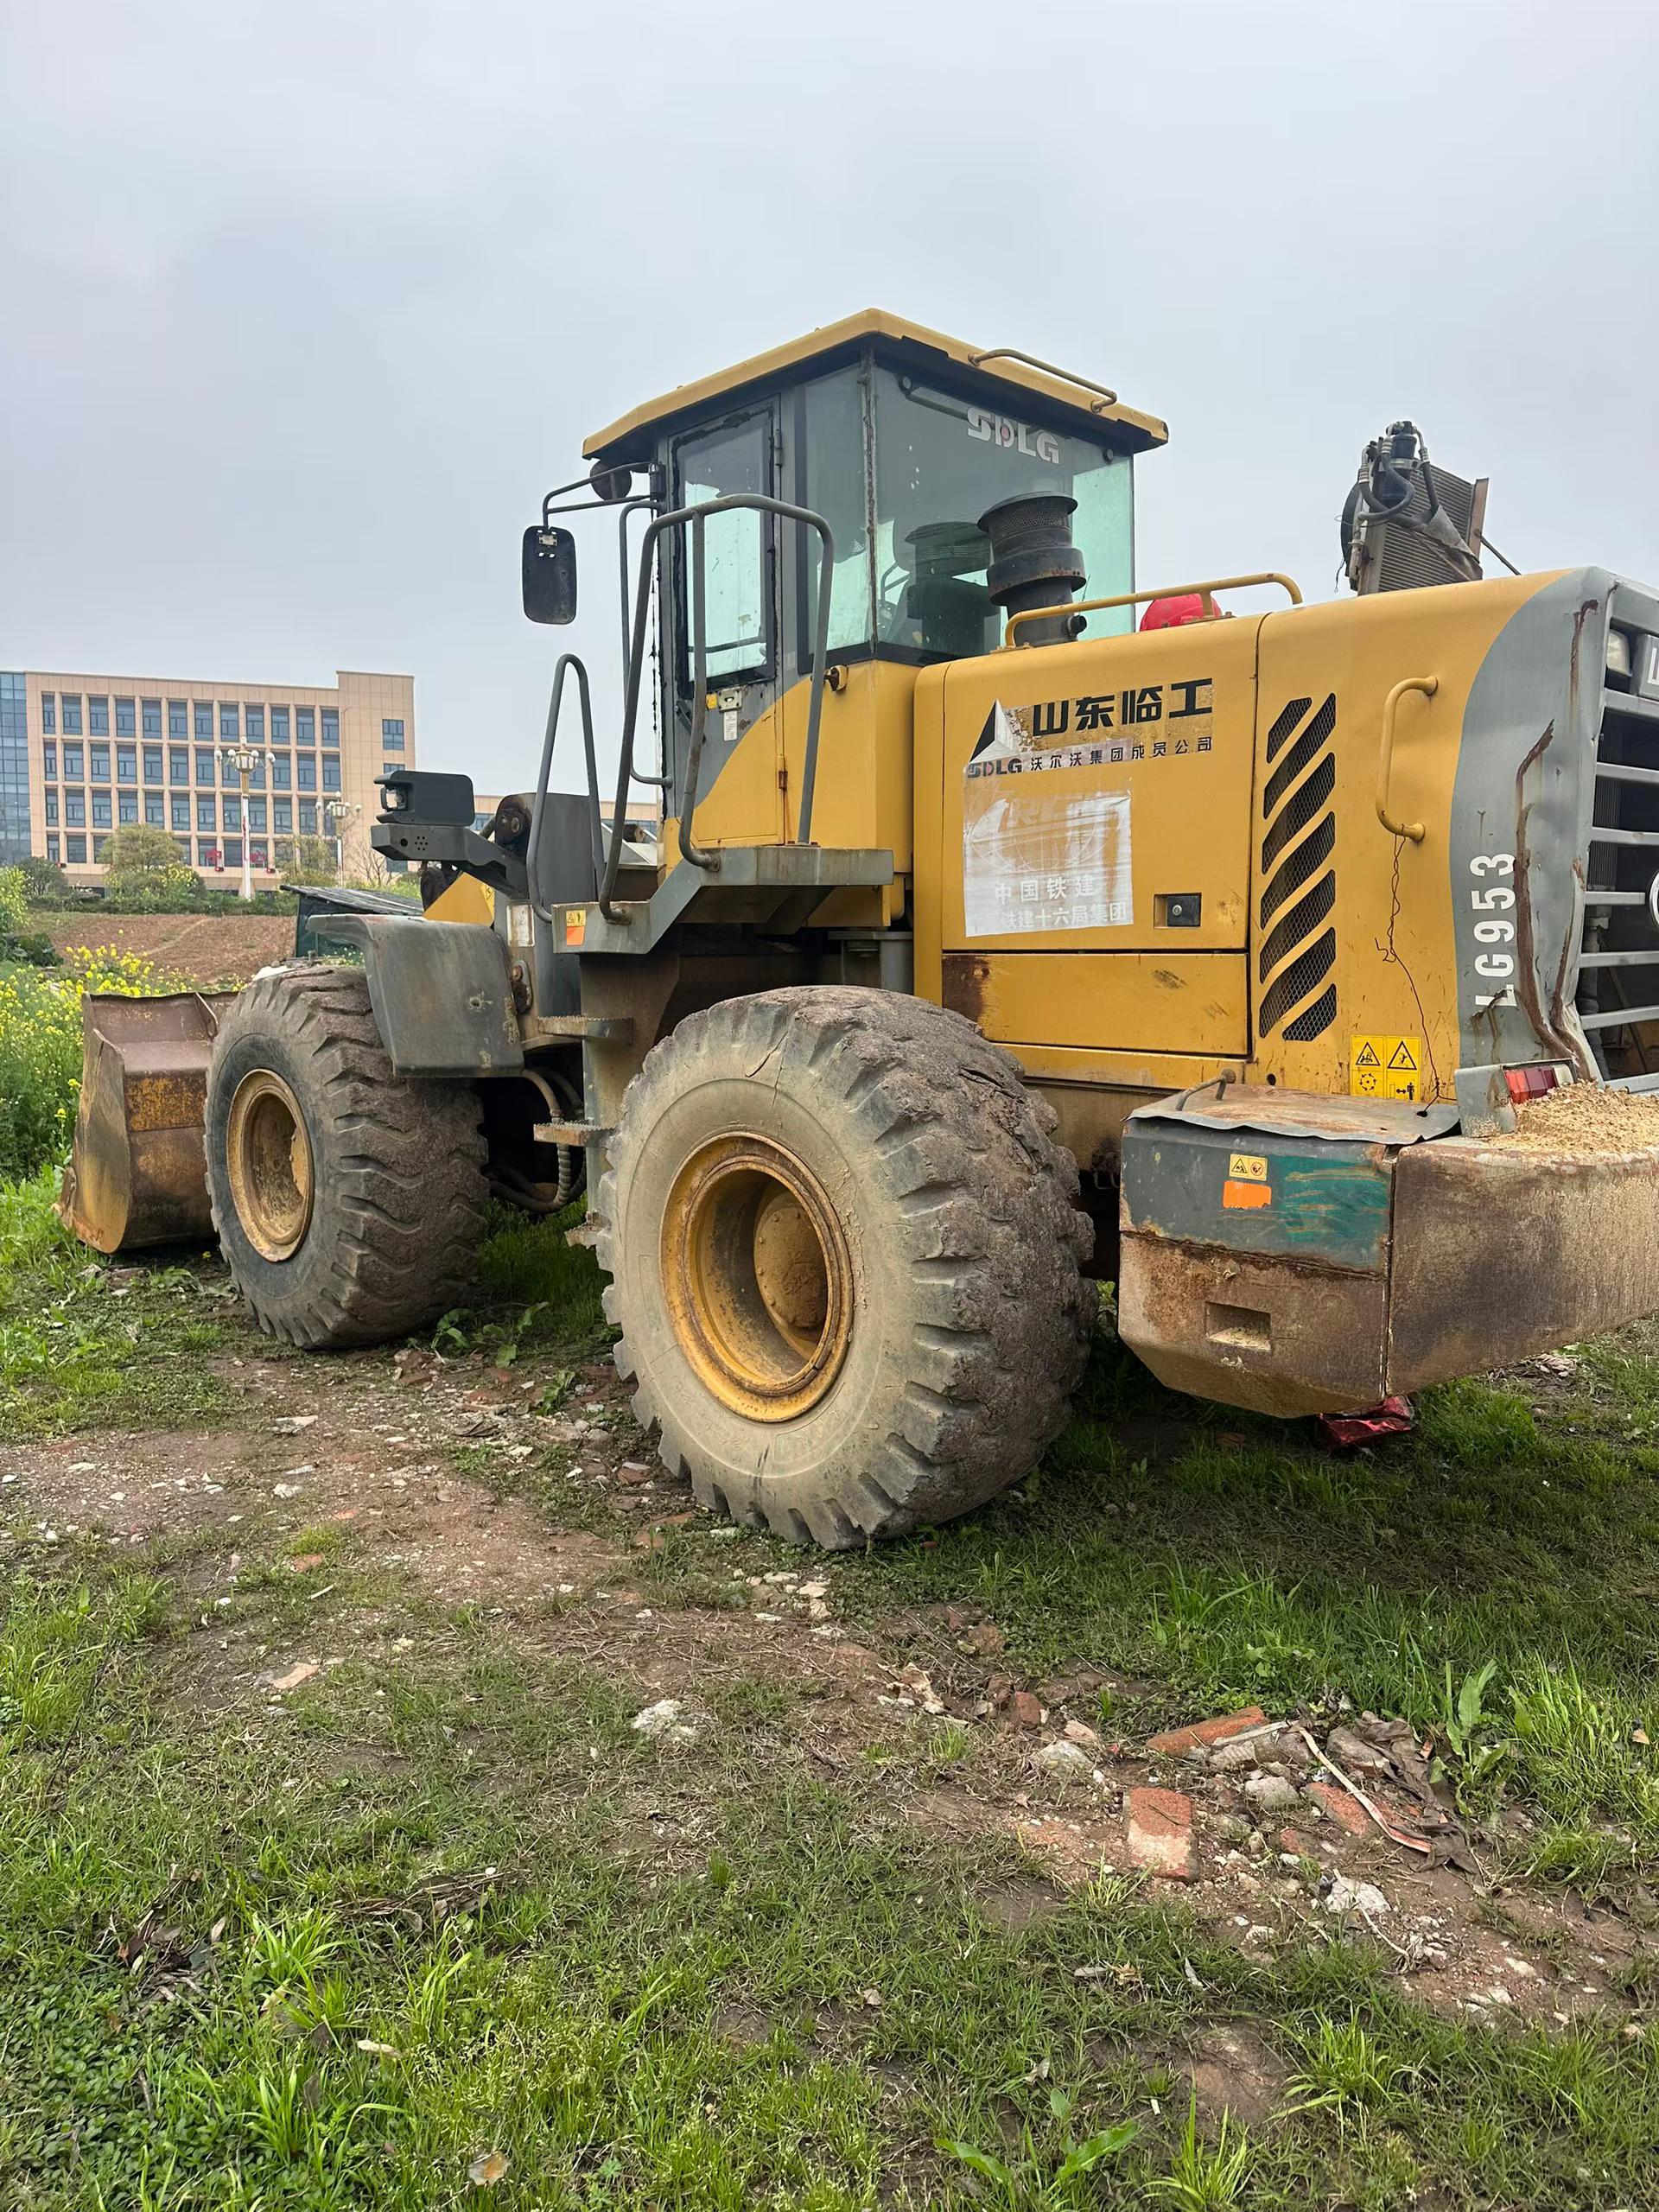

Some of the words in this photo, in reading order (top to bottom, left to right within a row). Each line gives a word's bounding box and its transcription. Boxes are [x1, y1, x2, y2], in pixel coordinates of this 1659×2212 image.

[967, 407, 1059, 464] SDLG
[1033, 677, 1212, 736] 山东临工
[967, 758, 1022, 779] SDLG
[1031, 736, 1211, 771] 沃尔沃集团成员公司
[995, 874, 1099, 905] 中国铁建
[1469, 853, 1517, 1007] LG953
